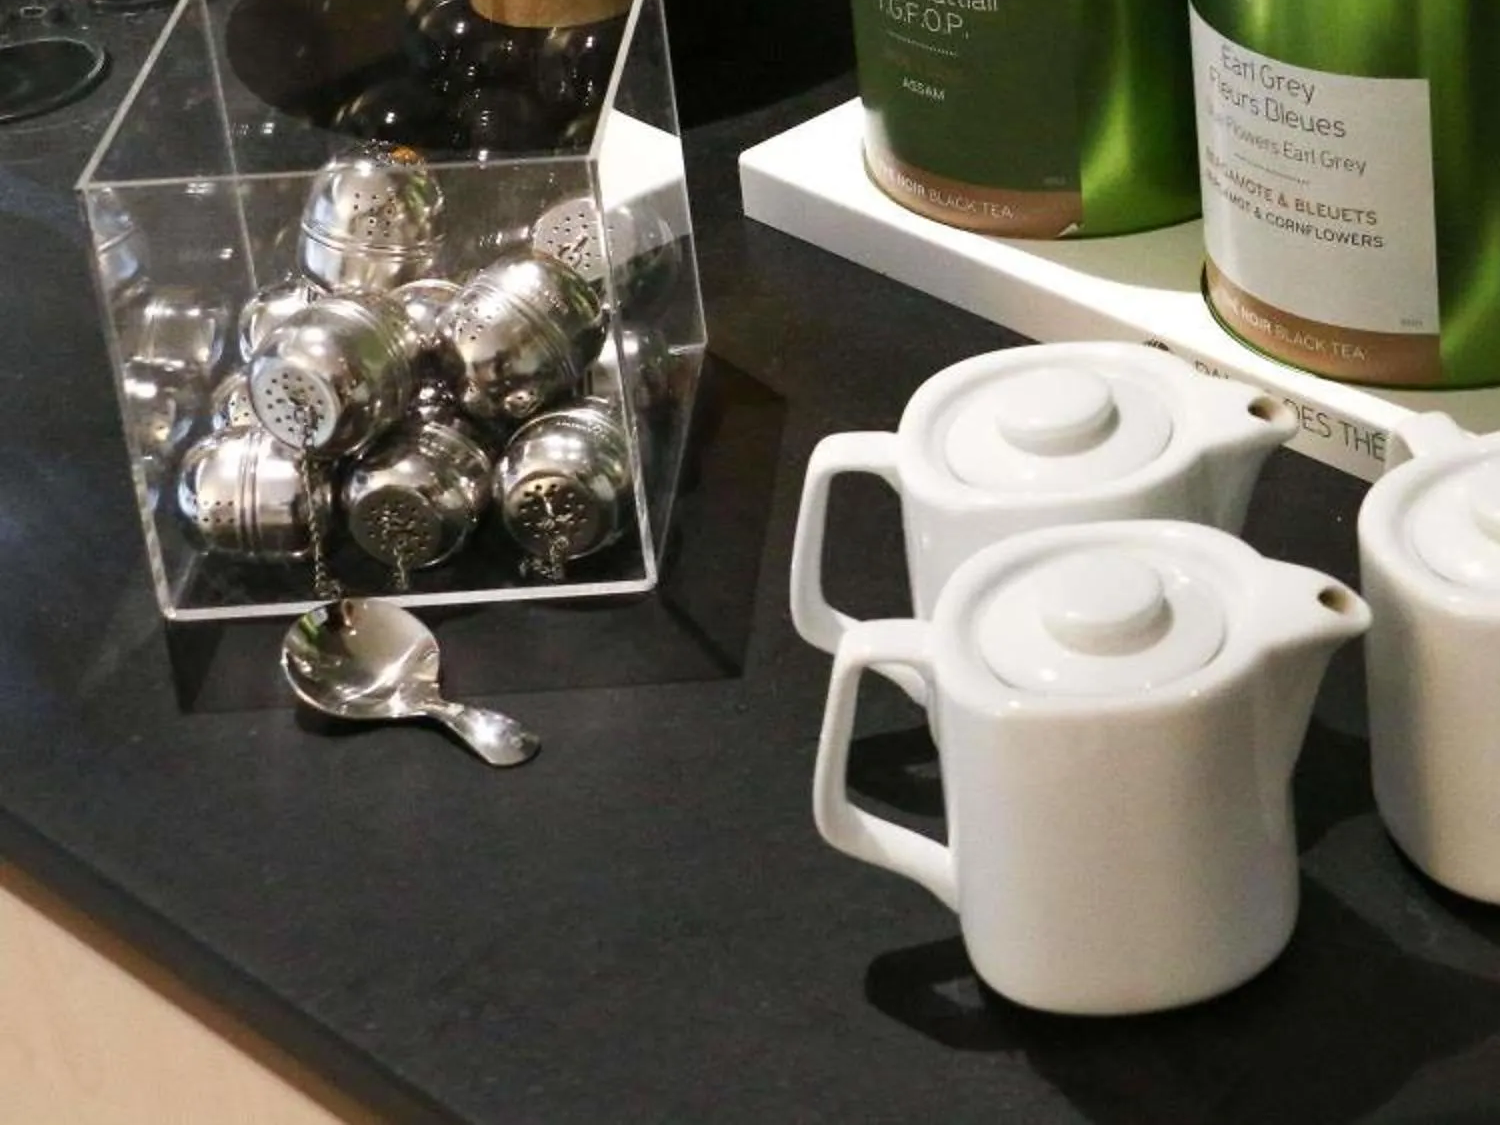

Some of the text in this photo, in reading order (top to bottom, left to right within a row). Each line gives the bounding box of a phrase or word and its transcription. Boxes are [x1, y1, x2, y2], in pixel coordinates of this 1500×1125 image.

[1220, 42, 1316, 106] Earl Grey
[1281, 139, 1317, 167] Earl
[1319, 149, 1368, 177] Grey
[982, 201, 1016, 220] TEA
[1294, 197, 1379, 227] BLEUETS
[1274, 324, 1326, 353] BLACK
[1330, 341, 1369, 361] TEA
[1338, 420, 1387, 462] THÉ
